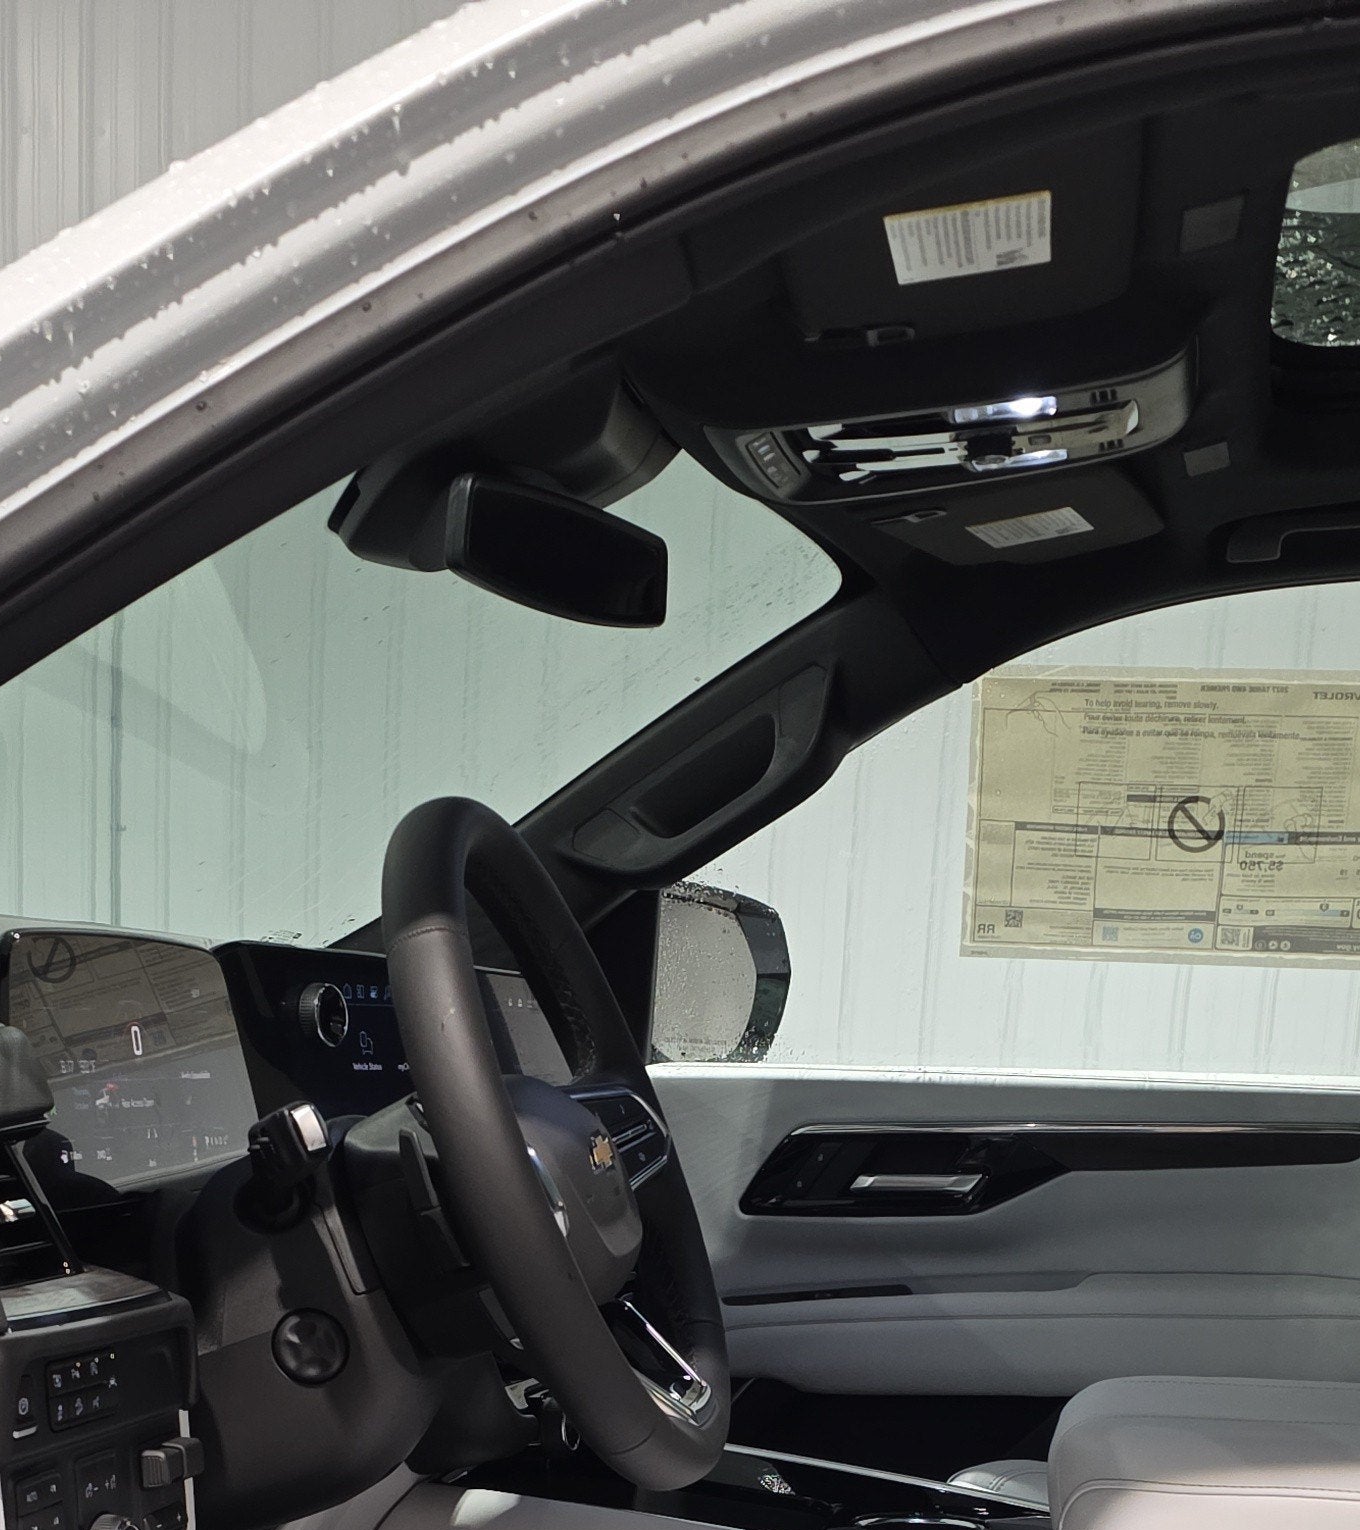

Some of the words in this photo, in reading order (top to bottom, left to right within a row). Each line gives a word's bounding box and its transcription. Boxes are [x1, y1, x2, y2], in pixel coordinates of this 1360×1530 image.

[1084, 698, 1095, 708] To
[1095, 699, 1112, 711] help
[1113, 699, 1133, 709] avoid
[1164, 702, 1191, 710] remove
[130, 1025, 143, 1056] 0
